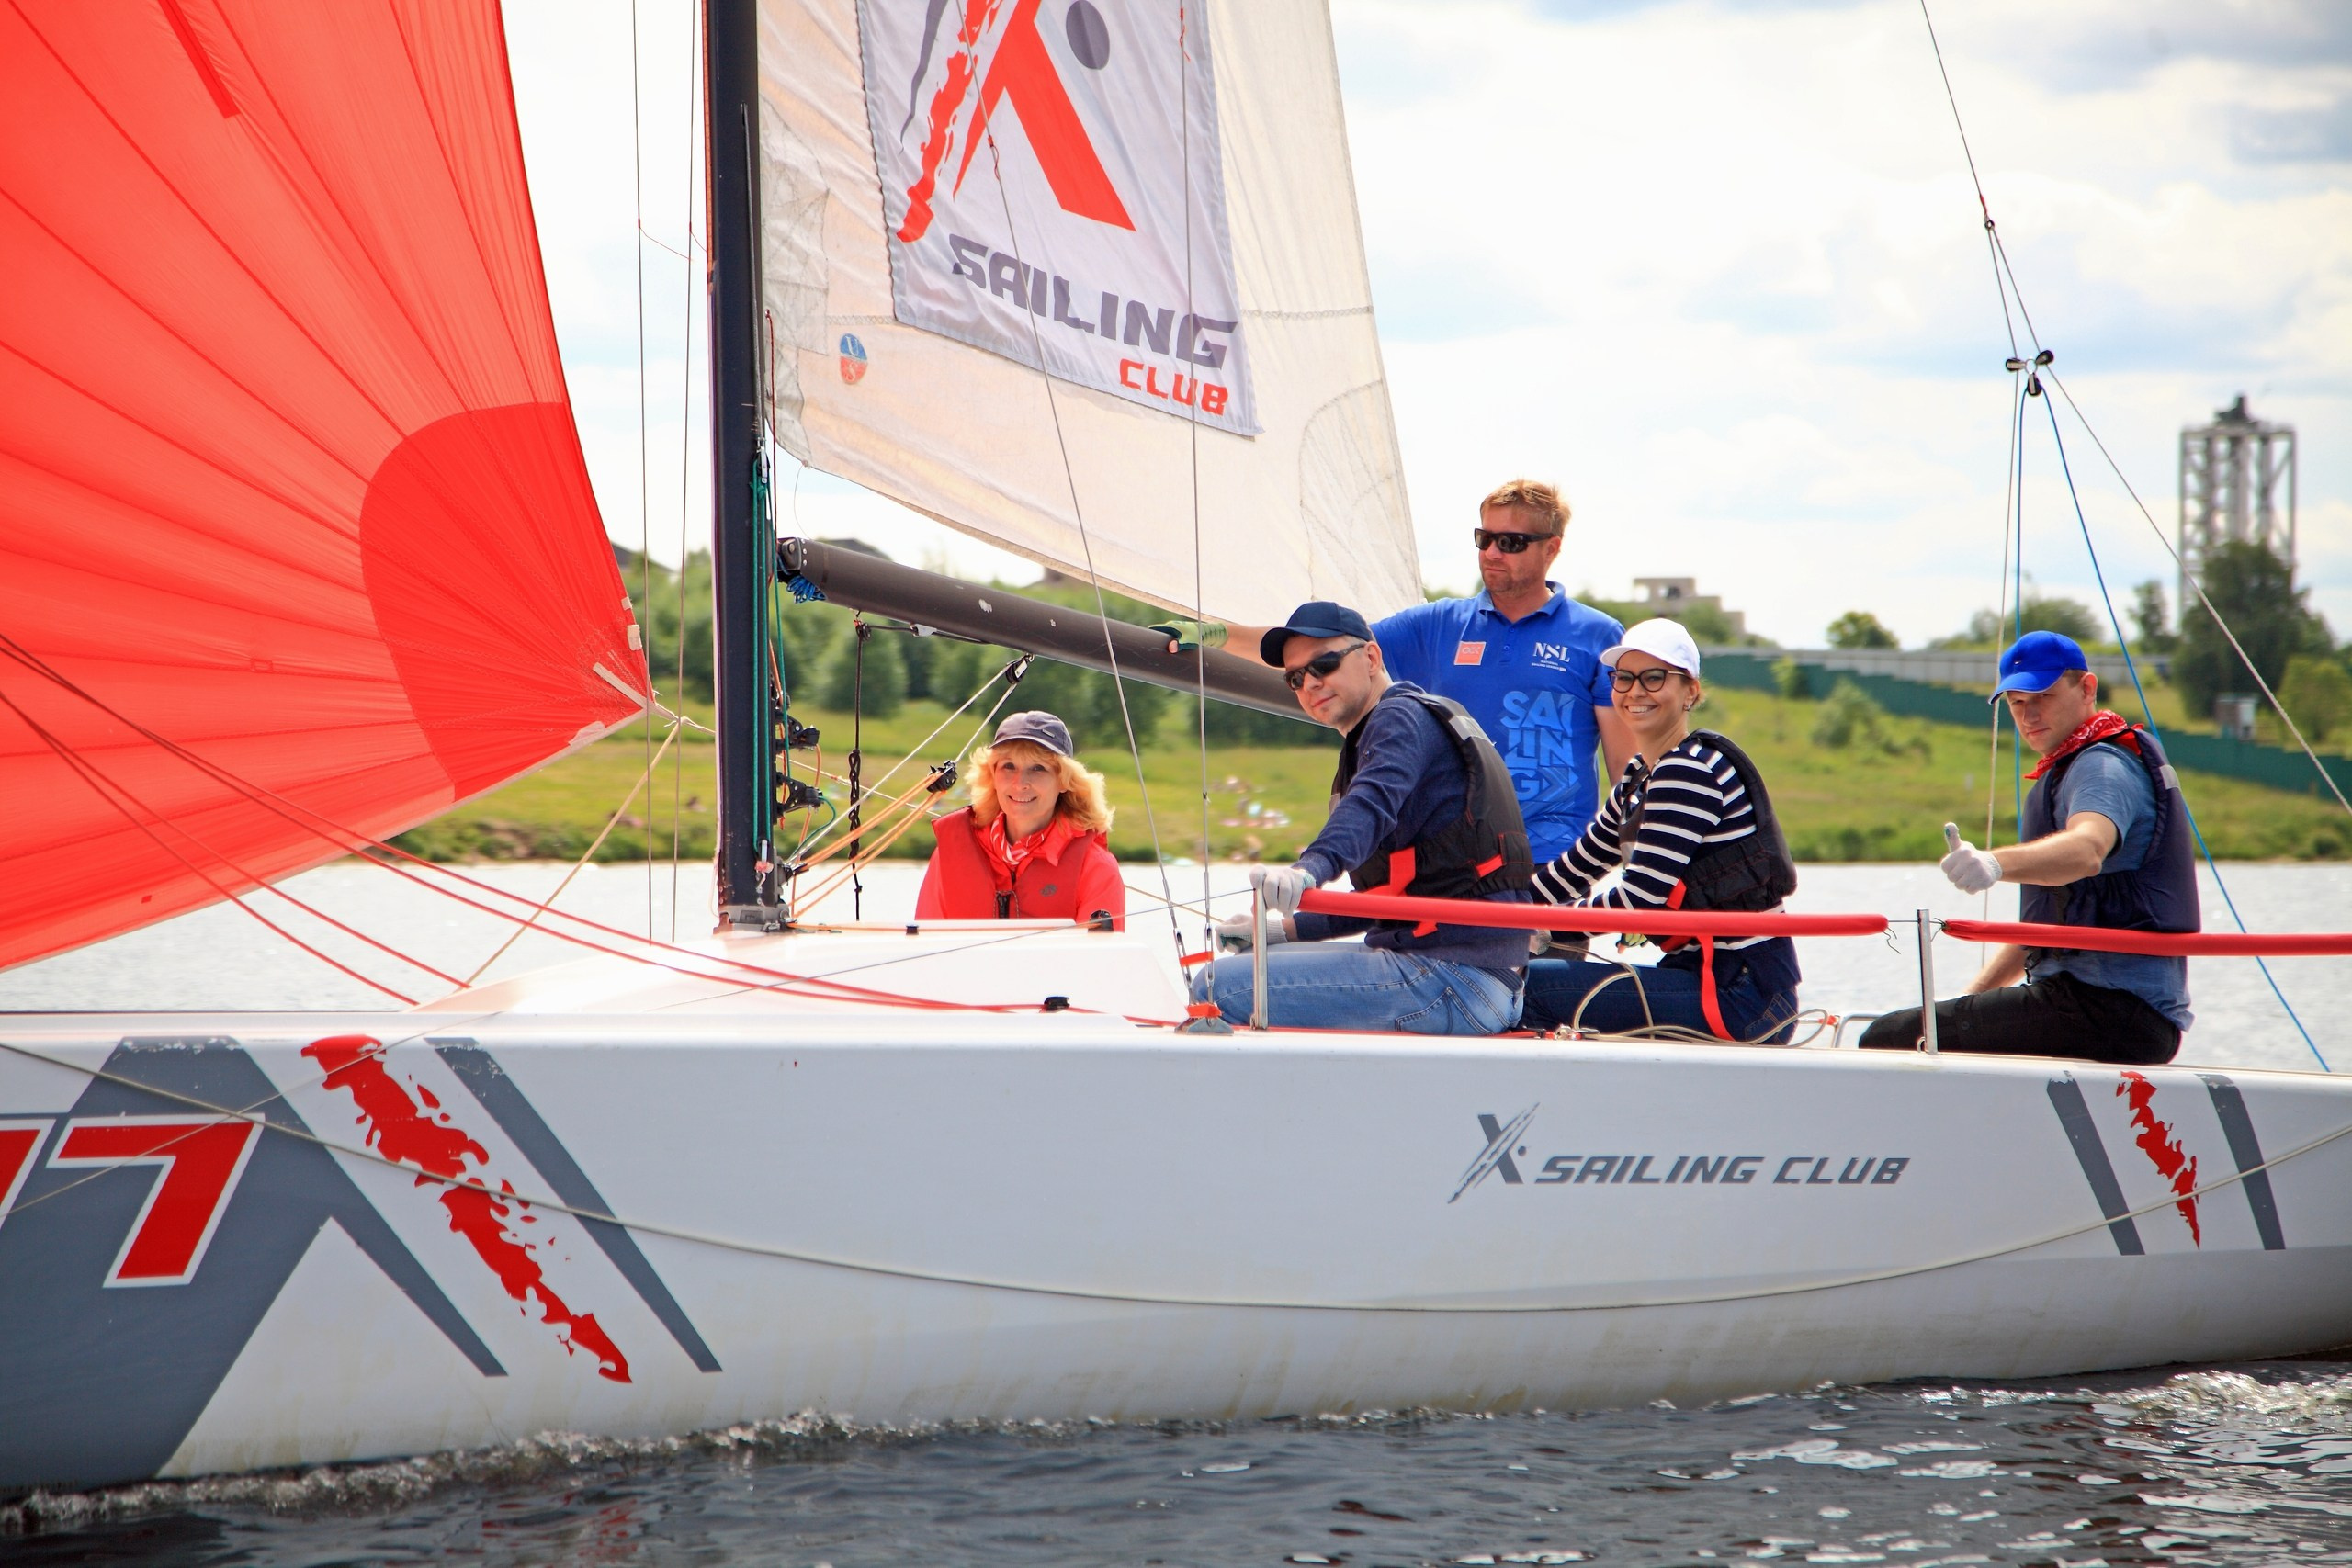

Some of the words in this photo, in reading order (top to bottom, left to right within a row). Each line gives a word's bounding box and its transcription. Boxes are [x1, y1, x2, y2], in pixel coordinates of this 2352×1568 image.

[948, 233, 1238, 370] SAILING
[1119, 358, 1229, 416] CLUB
[1532, 642, 1570, 662] NSL
[1534, 1156, 1766, 1185] SAILING
[1773, 1156, 1911, 1185] CLUB
